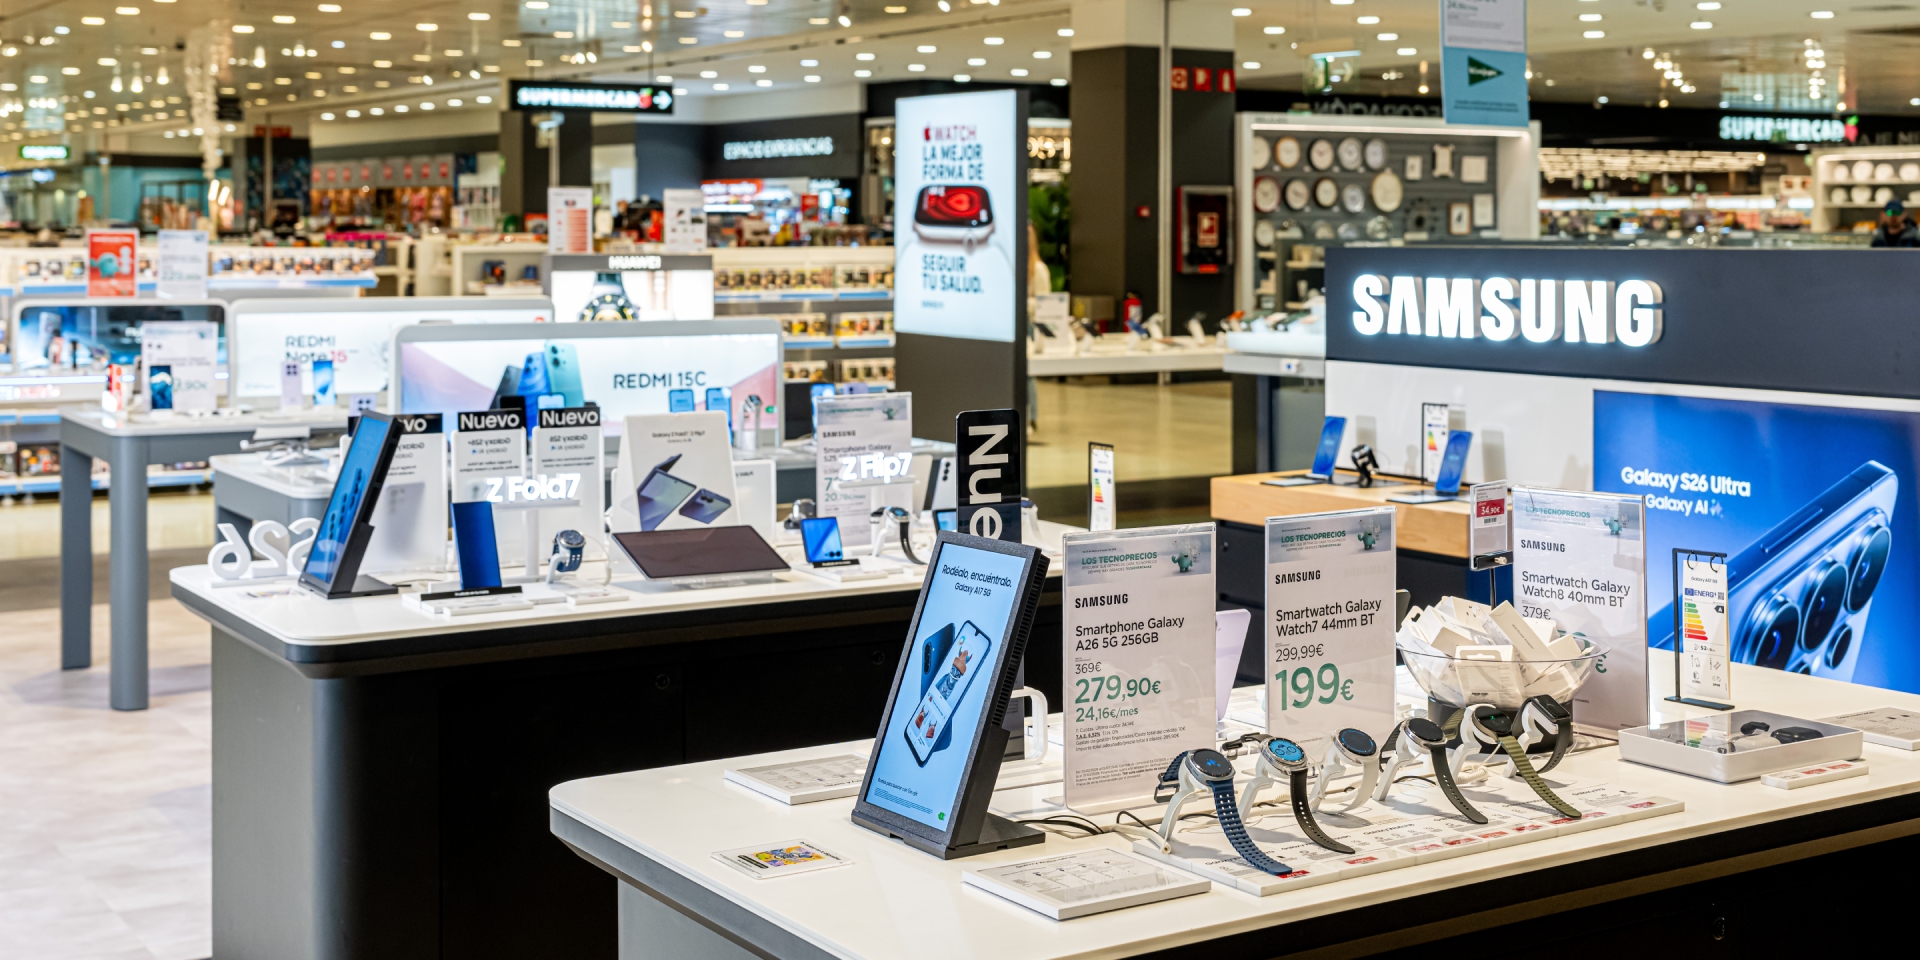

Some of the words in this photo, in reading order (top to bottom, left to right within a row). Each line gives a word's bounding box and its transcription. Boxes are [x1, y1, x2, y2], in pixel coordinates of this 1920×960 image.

[934, 125, 977, 142] WATCH
[922, 144, 937, 162] LA
[941, 143, 983, 161] MEJOR
[922, 163, 964, 181] FORMA
[968, 163, 984, 180] DE
[609, 255, 661, 269] HUAWEI
[922, 254, 966, 272] SEGUIR
[923, 273, 938, 290] TU
[941, 275, 984, 294] SALUD.
[1352, 274, 1663, 347] SAMSUNG
[286, 336, 336, 348] REDMI
[286, 352, 327, 363] Note
[330, 350, 348, 363] 15
[613, 373, 672, 389] REDMI
[678, 371, 706, 386] 15C
[460, 413, 520, 430] Nuevo
[542, 410, 599, 426] Nuevo
[822, 430, 856, 438] SAMSUNG
[823, 445, 867, 455] Smartphone
[868, 444, 892, 452] Galaxy
[841, 456, 858, 481] Z
[860, 452, 913, 484] Flip7
[486, 477, 503, 502] Z
[508, 473, 581, 501] Fold7
[968, 424, 1009, 540] Nue
[1620, 466, 1679, 494] Galaxy
[1680, 472, 1709, 493] S26
[1710, 475, 1751, 498] Ultra
[1539, 508, 1591, 519] TECNOPRECIOS
[1645, 494, 1693, 517] Galaxy
[1694, 499, 1709, 515] AI
[1281, 535, 1294, 543] LOS
[1295, 530, 1346, 542] TECNOPRECIOS
[1521, 539, 1566, 553] SAMSUNG
[1081, 556, 1097, 565] LOS
[1099, 552, 1158, 564] TECNOPRECIOS
[941, 564, 969, 580] Rodéalo,
[970, 572, 1012, 588] encuéntralo.
[1275, 570, 1321, 585] SAMSUNG
[1522, 571, 1588, 590] Smartwatch
[1591, 580, 1631, 596] Galaxy
[955, 582, 974, 596] Galaxy
[974, 586, 983, 595] A17
[983, 588, 992, 597] 5G
[1522, 584, 1565, 600] Watch8
[1568, 591, 1606, 606] 40mm
[1609, 596, 1625, 608] BT
[1075, 594, 1129, 609] SAMSUNG
[1276, 602, 1342, 622] Smartwatch
[1345, 599, 1382, 613] Galaxy
[1522, 605, 1551, 620] 379€
[1076, 621, 1145, 637] Smartphone
[1147, 617, 1185, 629] Galaxy
[1276, 621, 1319, 637] Watch7
[1321, 617, 1357, 631] 44mm
[1361, 613, 1375, 626] BT
[1076, 639, 1099, 651] A26
[1102, 636, 1118, 648] 5G
[1121, 632, 1159, 646] 256GB
[1275, 643, 1324, 663] 299,99€
[1075, 662, 1102, 675] 369€
[1075, 675, 1162, 704] 279,90€
[1275, 663, 1354, 711] 199€
[1076, 706, 1139, 722] 24,16€/mes
